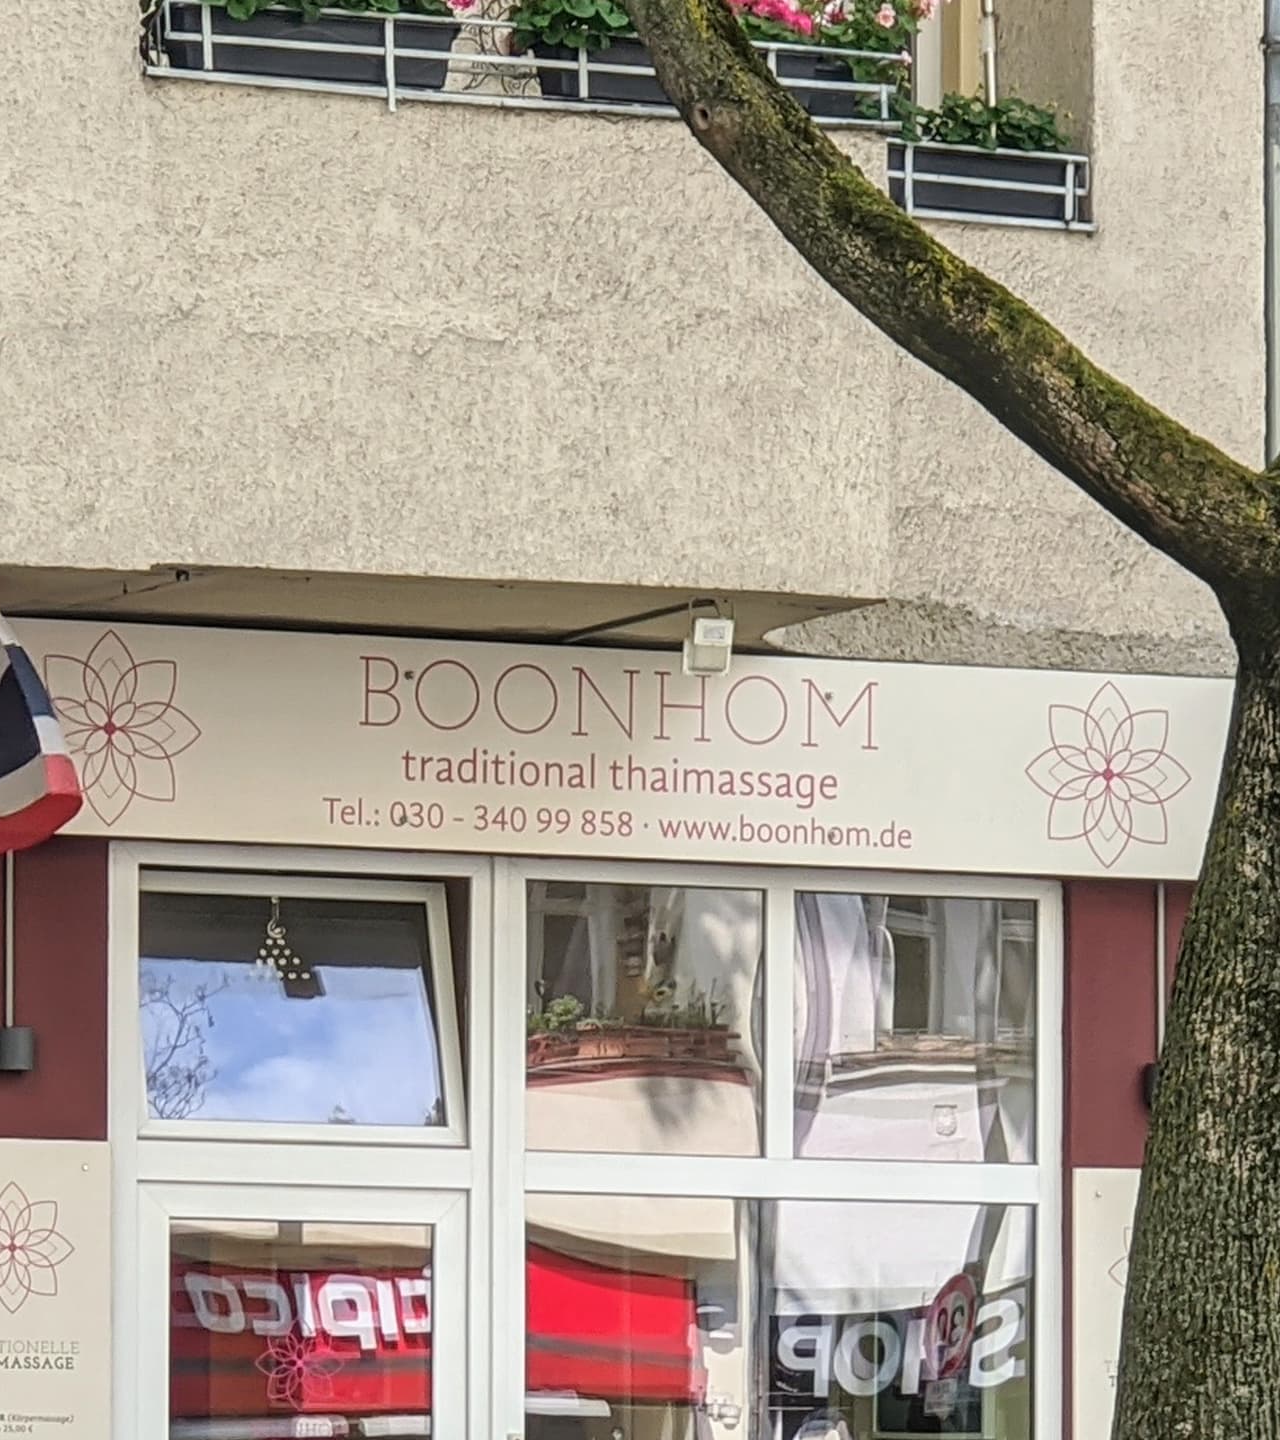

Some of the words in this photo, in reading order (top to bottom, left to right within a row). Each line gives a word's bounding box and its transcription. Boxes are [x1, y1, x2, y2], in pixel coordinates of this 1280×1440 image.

[358, 656, 880, 751] BOONHOM
[402, 748, 596, 791] traditional
[610, 756, 839, 809] thaimassage
[321, 798, 381, 829] Tel.:
[389, 801, 445, 830] 030
[473, 804, 527, 834] 340
[536, 807, 572, 835] 99
[581, 809, 634, 838] 858
[658, 813, 914, 851] www.boonhom.de
